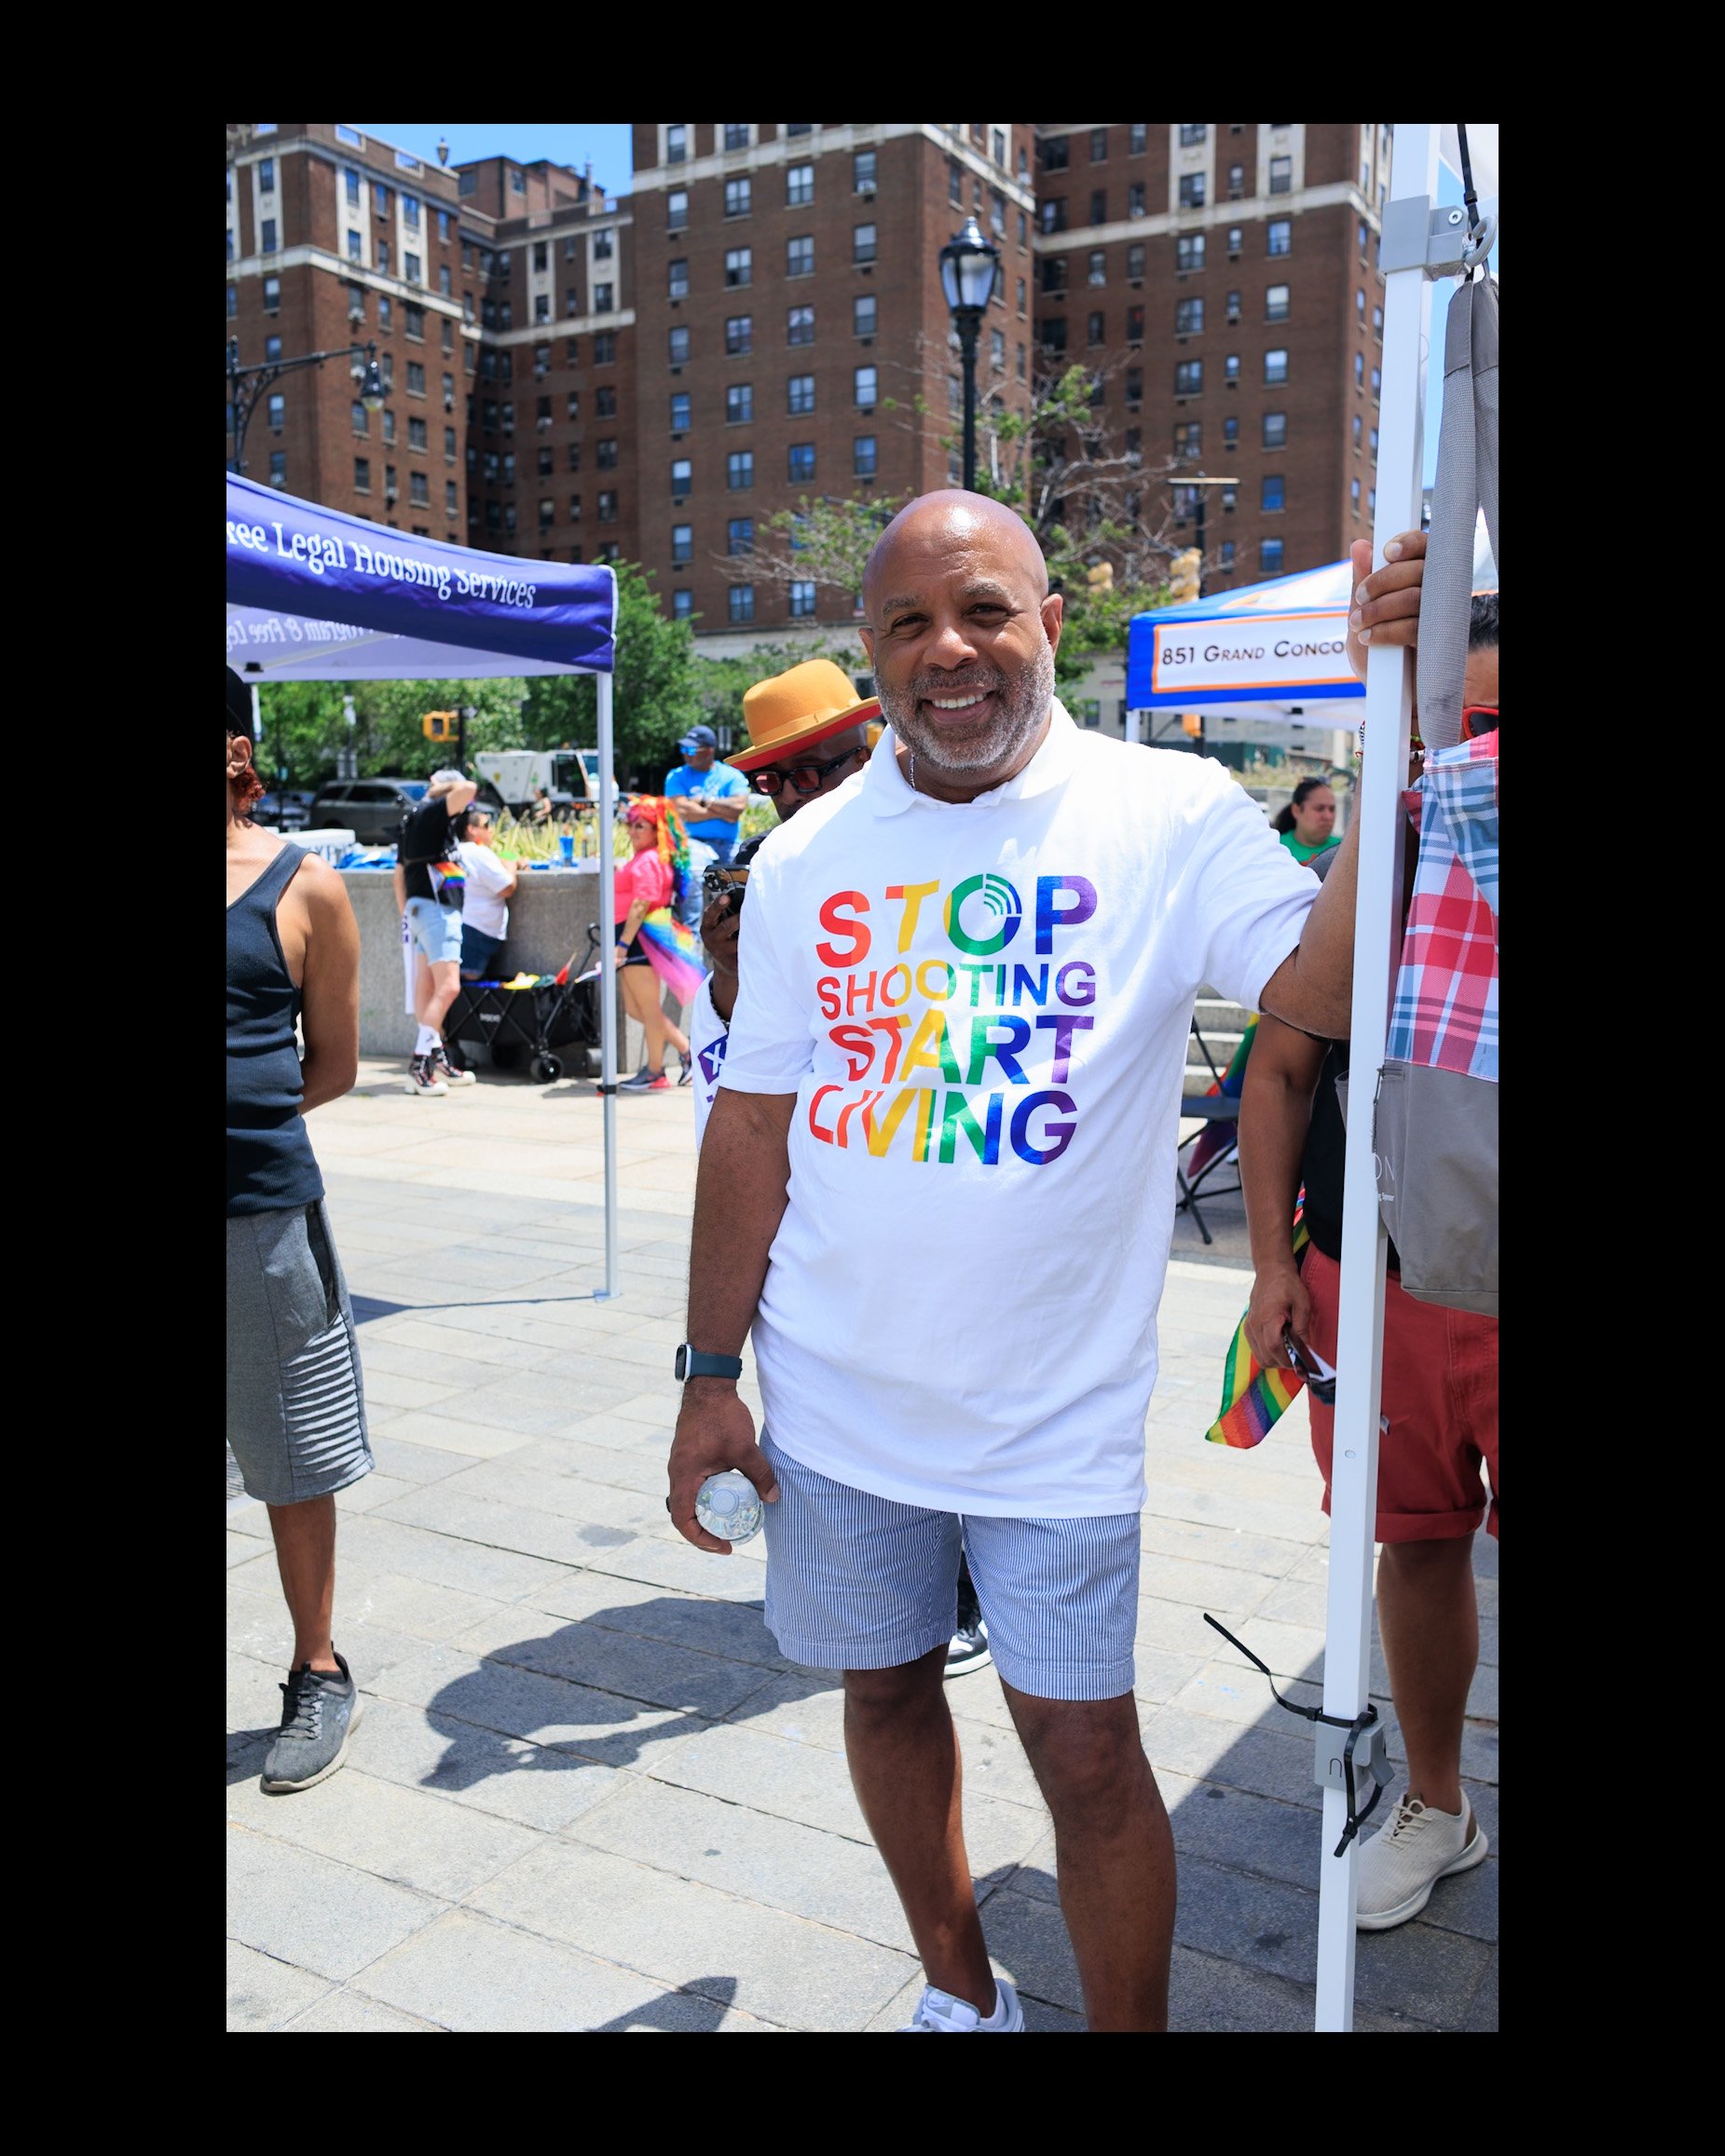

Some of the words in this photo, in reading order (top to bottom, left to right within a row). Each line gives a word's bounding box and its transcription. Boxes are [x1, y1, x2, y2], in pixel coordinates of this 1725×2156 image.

[271, 522, 348, 575] Legal
[348, 540, 451, 601] Housing
[453, 567, 536, 608] Services
[1162, 647, 1195, 664] 851
[815, 873, 1098, 968] STOP
[816, 959, 1096, 1020] SHOOTING
[828, 1008, 1094, 1085] START
[809, 1085, 1077, 1165] LIVING
